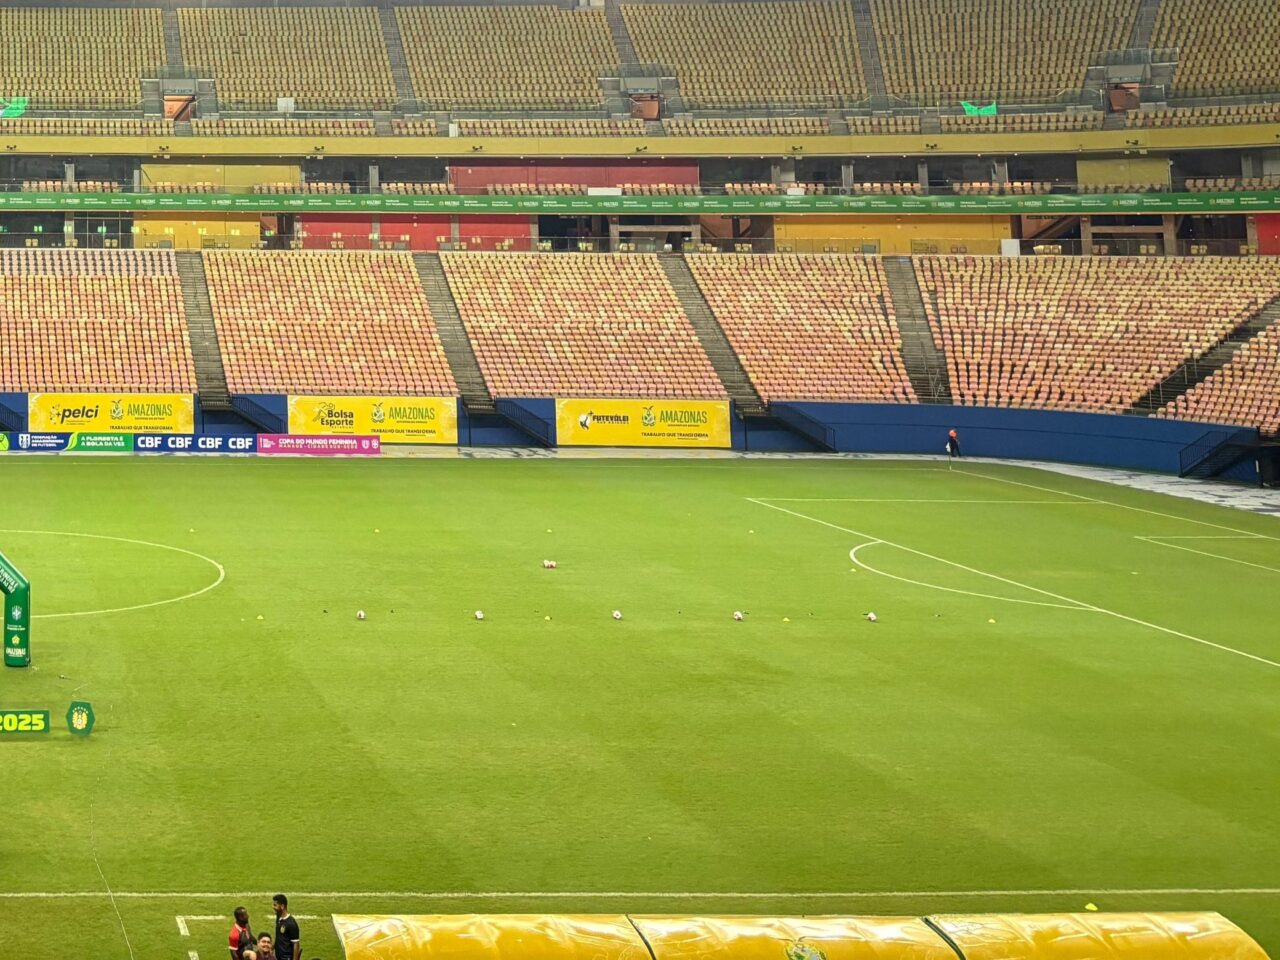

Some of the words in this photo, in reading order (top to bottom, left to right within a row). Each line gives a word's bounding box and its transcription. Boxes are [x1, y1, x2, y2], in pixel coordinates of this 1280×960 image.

[127, 403, 173, 417] AMAZONAS
[327, 409, 354, 419] Bolsa
[388, 406, 435, 420] AMAZONAS
[321, 418, 354, 427] Esporte
[659, 410, 708, 424] AMAZONAS
[137, 436, 162, 448] CBF
[167, 437, 192, 448] CBF
[198, 437, 223, 449] CBF
[228, 438, 253, 449] CBF
